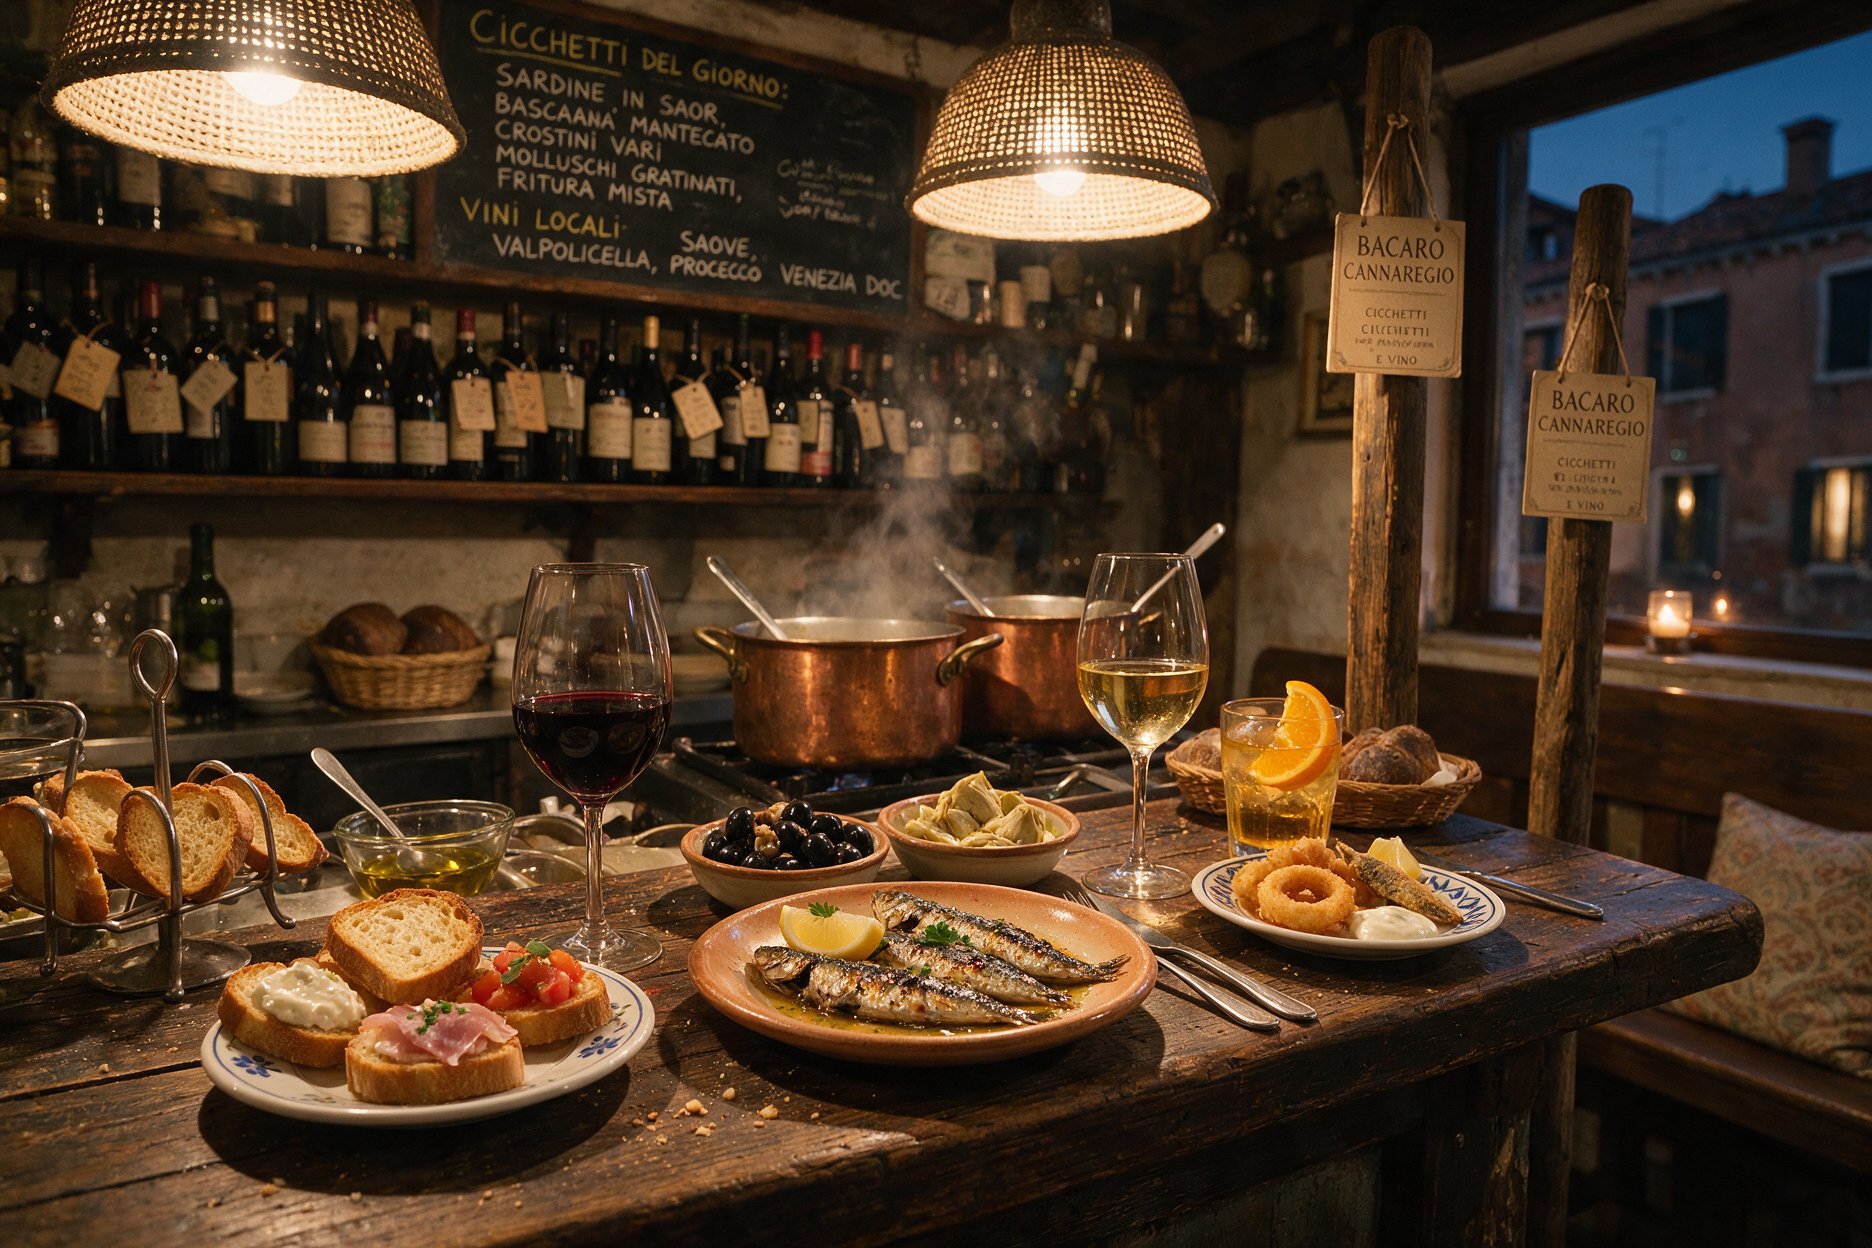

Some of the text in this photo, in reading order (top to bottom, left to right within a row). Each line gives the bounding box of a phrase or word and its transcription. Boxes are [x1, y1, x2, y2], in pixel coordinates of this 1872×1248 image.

[641, 46, 683, 77] DEL
[622, 88, 645, 110] IN
[494, 119, 662, 163] CROSTINI VARI
[630, 115, 756, 156] MANTECATO
[495, 143, 617, 179] MOLLUSCHI
[631, 162, 743, 204] GRATINATI,
[497, 166, 674, 212] FRITURA MISTA
[460, 196, 519, 227] VINI
[1357, 235, 1445, 260] BACARO
[491, 232, 659, 276] VALPOLICELLA,
[669, 253, 763, 283] PROCECCO
[779, 262, 858, 294] VENEZIA
[865, 273, 904, 300] DOC
[1343, 262, 1455, 285] CANNAREGIO
[1365, 307, 1427, 321] CICCHETTI
[1376, 354, 1418, 366] E VINO
[1551, 389, 1635, 414] BACARO
[1538, 415, 1645, 437] CANNAREGIO
[1557, 457, 1616, 470] CICCHETTI
[1577, 500, 1605, 511] VINO
